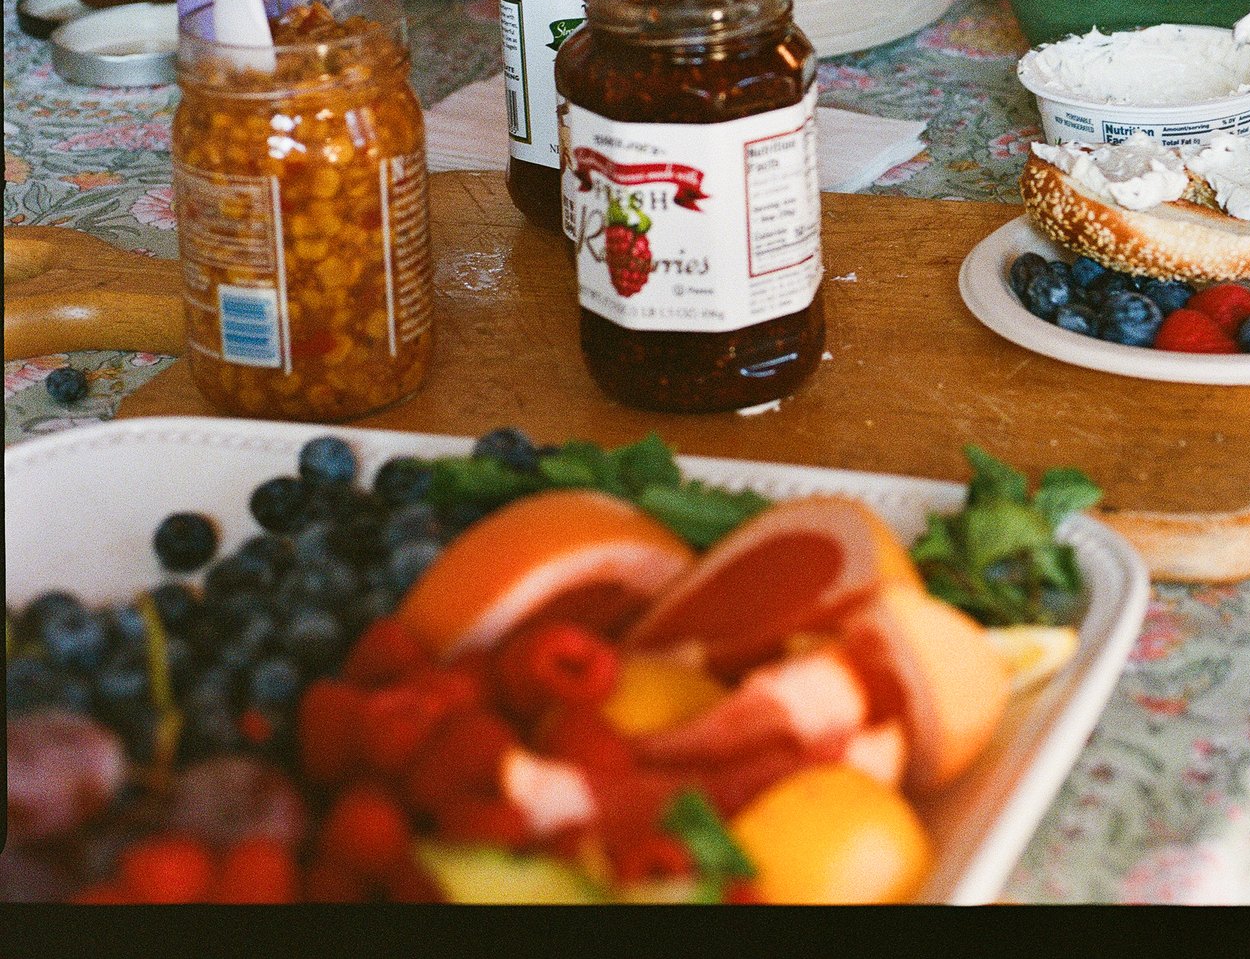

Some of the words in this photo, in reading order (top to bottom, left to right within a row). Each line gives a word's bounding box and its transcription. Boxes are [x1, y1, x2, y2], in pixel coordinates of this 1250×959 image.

[1105, 124, 1155, 137] Nutrin
[1163, 124, 1210, 133] Amount/serving
[1162, 139, 1180, 147] Total
[1181, 138, 1192, 146] Fat
